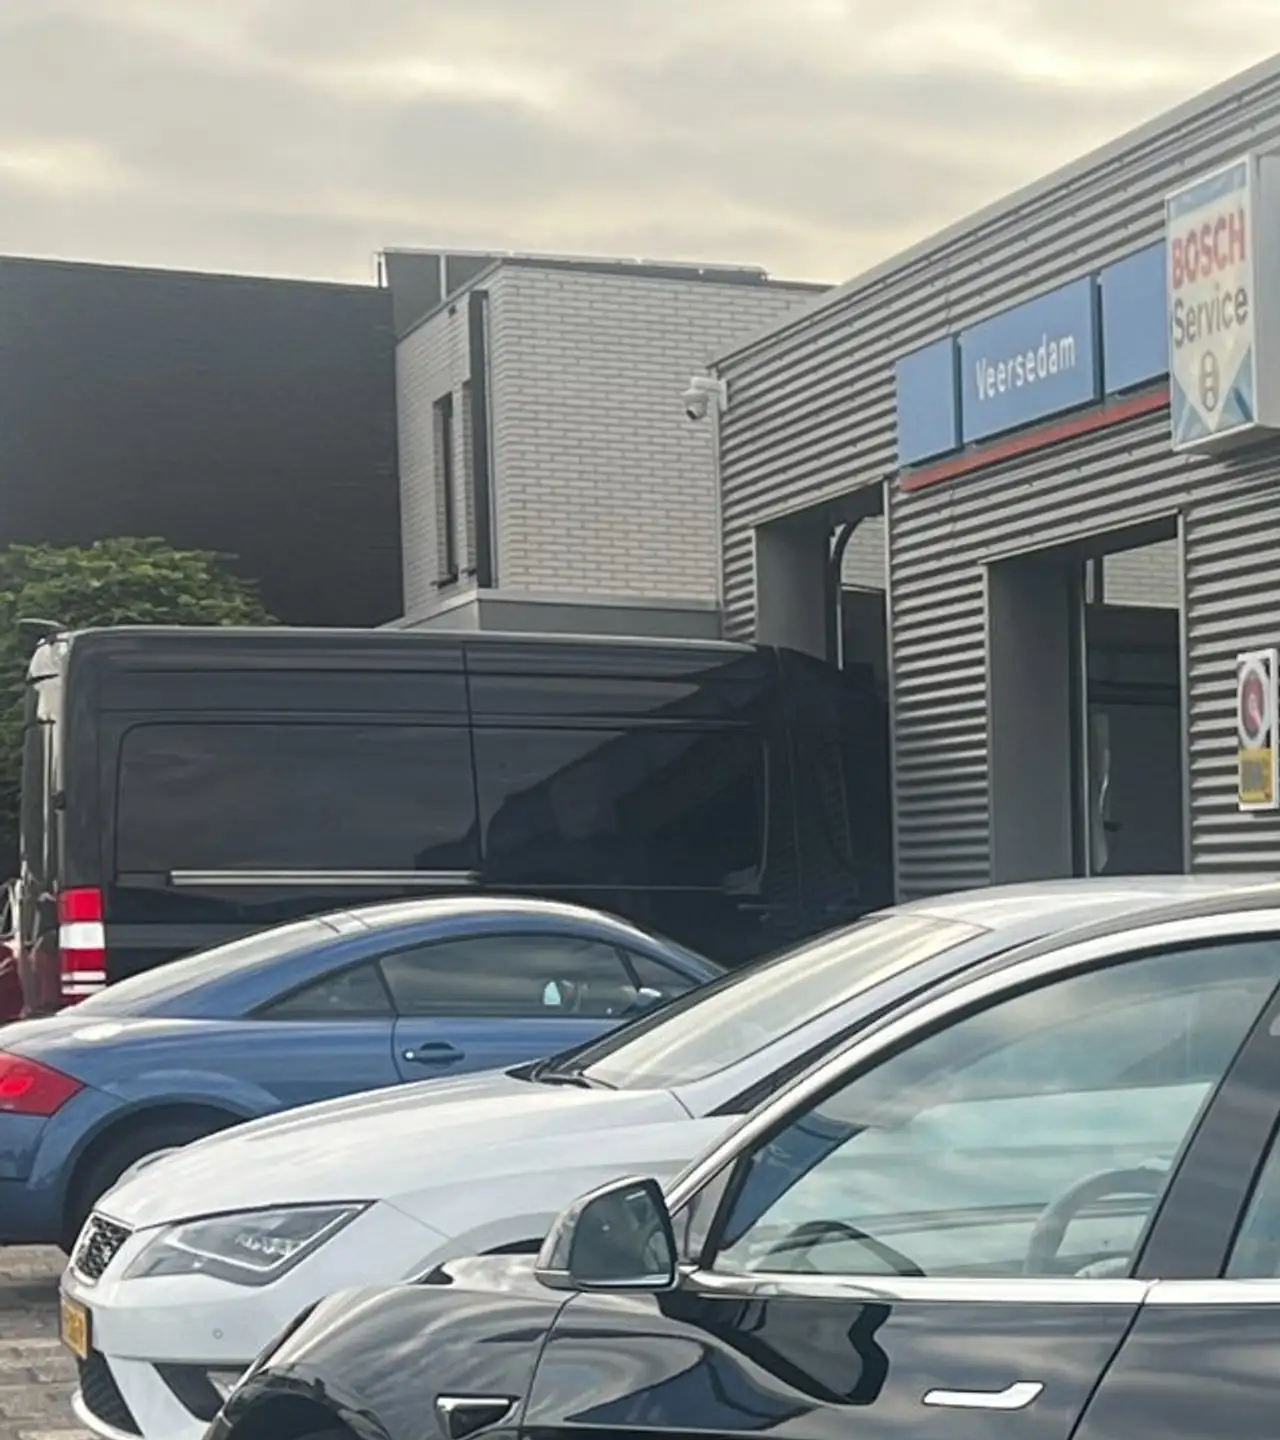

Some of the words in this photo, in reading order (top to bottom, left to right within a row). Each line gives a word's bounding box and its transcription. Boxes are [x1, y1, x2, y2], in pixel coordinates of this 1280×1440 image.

[1171, 208, 1246, 289] BOSCH
[1172, 283, 1249, 349] Service
[976, 332, 1076, 401] Veersedam
